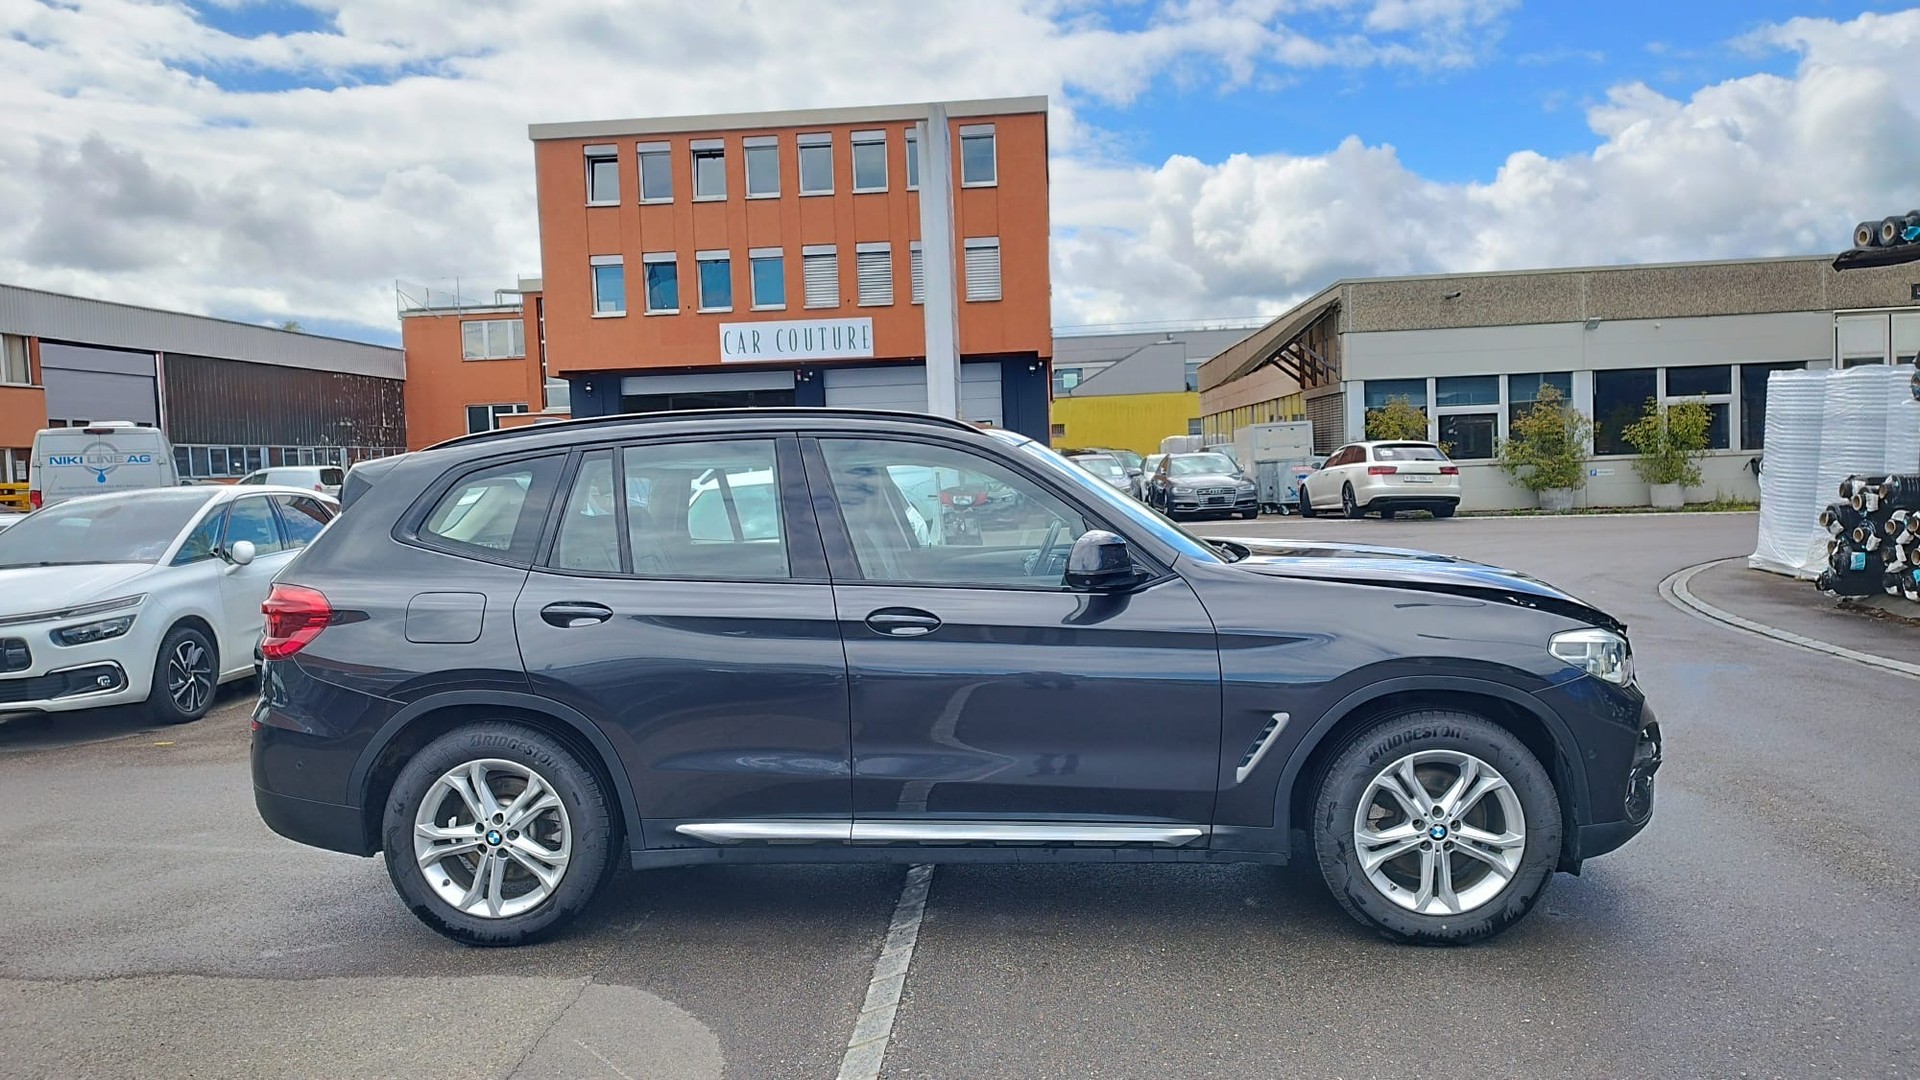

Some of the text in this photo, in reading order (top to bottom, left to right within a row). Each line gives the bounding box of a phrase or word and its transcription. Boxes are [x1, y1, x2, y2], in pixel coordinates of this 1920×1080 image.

[723, 325, 871, 355] CAR COUTURE
[49, 454, 151, 465] NIKI LINE AG
